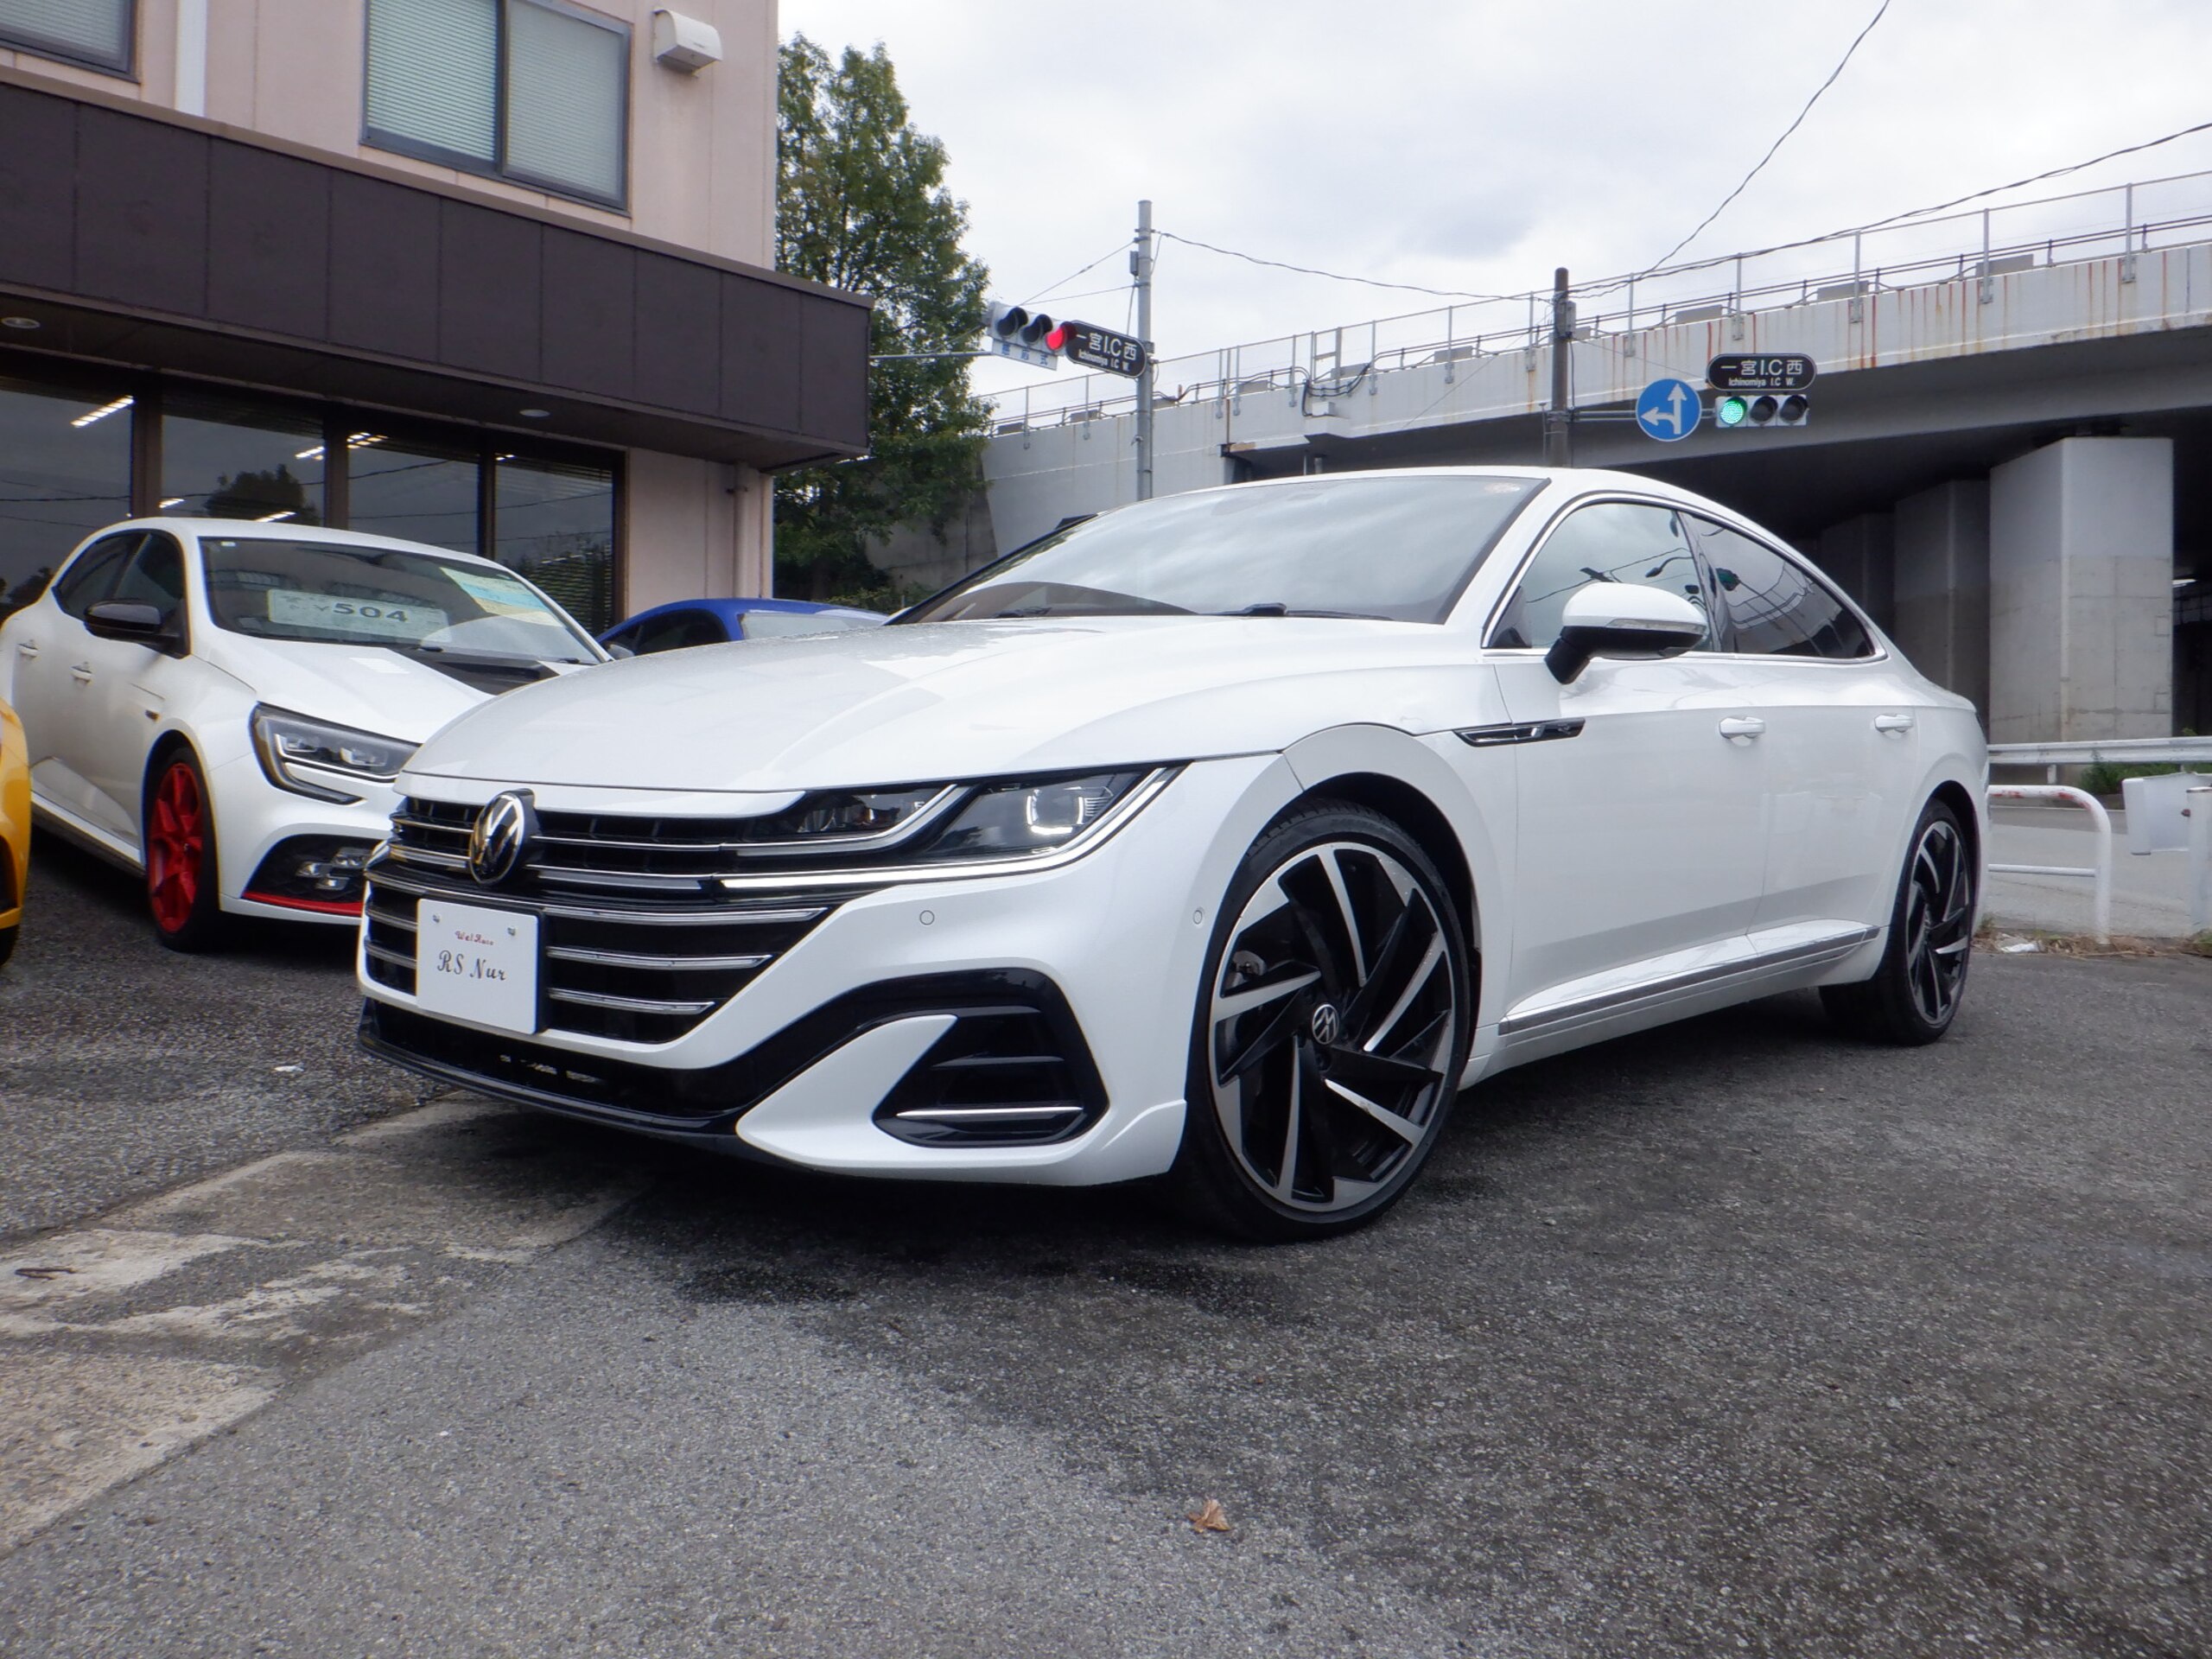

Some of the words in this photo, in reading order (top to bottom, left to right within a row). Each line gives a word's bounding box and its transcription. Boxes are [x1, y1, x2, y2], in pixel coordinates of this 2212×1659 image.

[1720, 359, 1803, 376] 一宮I.C西
[1728, 378, 1766, 388] Ichinomiya
[437, 950, 464, 975] RS
[470, 957, 506, 981] Nur
